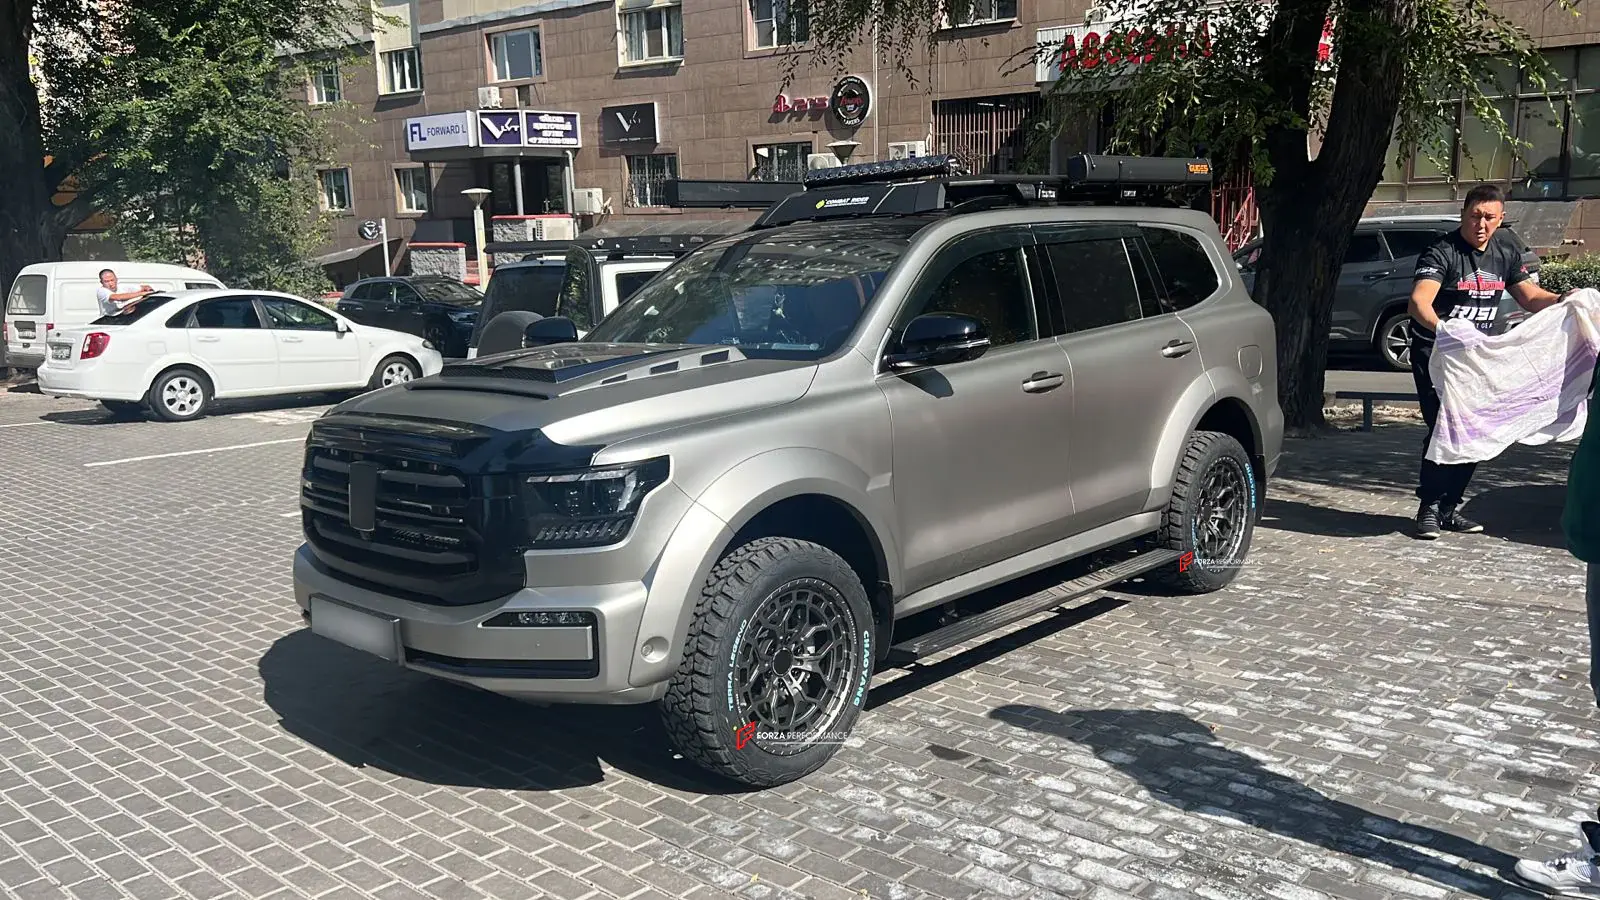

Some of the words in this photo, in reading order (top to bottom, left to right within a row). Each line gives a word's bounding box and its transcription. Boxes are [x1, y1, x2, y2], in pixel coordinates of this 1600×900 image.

[427, 125, 460, 136] FORWARD
[729, 619, 747, 667] LEGEND
[853, 630, 870, 706] CHAOYANG
